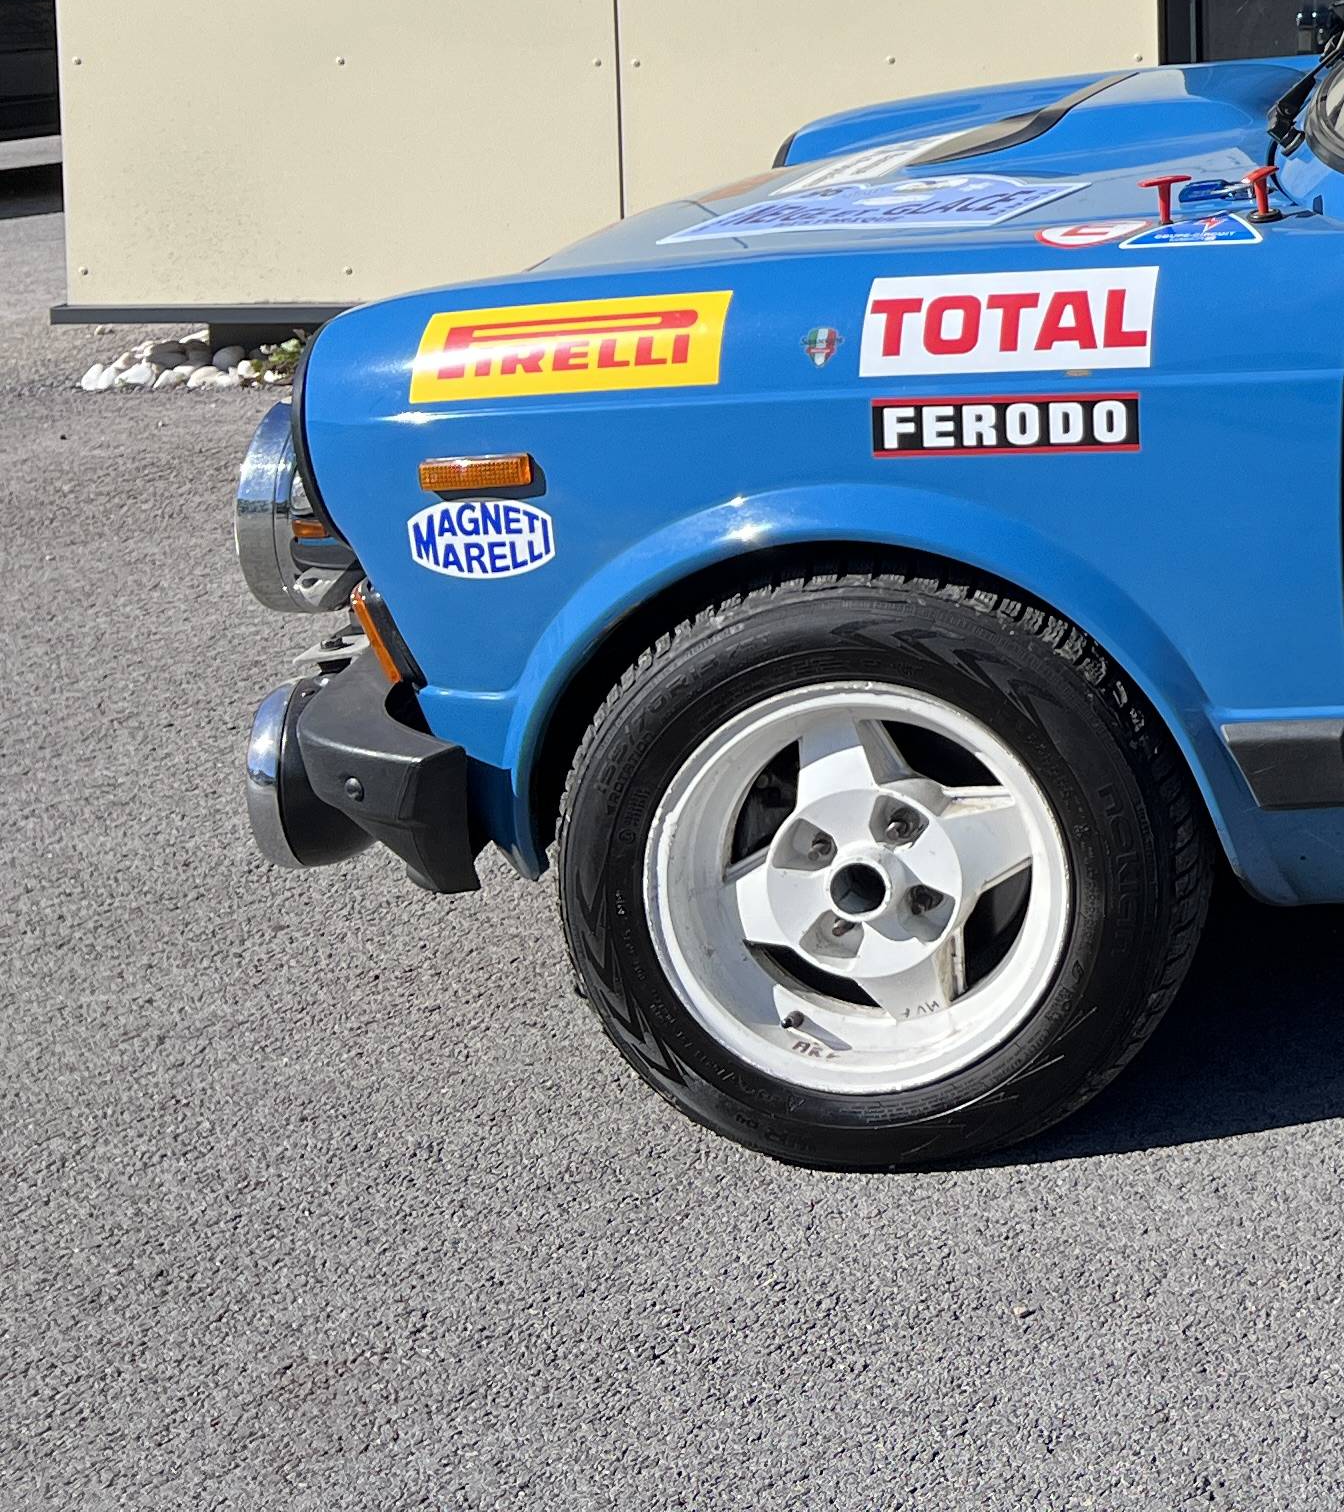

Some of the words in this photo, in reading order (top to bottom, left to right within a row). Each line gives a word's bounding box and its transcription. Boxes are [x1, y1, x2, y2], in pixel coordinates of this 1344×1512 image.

[882, 189, 1037, 216] GLACE
[436, 309, 699, 380] PIRELLI
[871, 289, 1148, 357] TOTAL
[882, 400, 1127, 449] FERODO
[412, 501, 551, 560] MAGNETI
